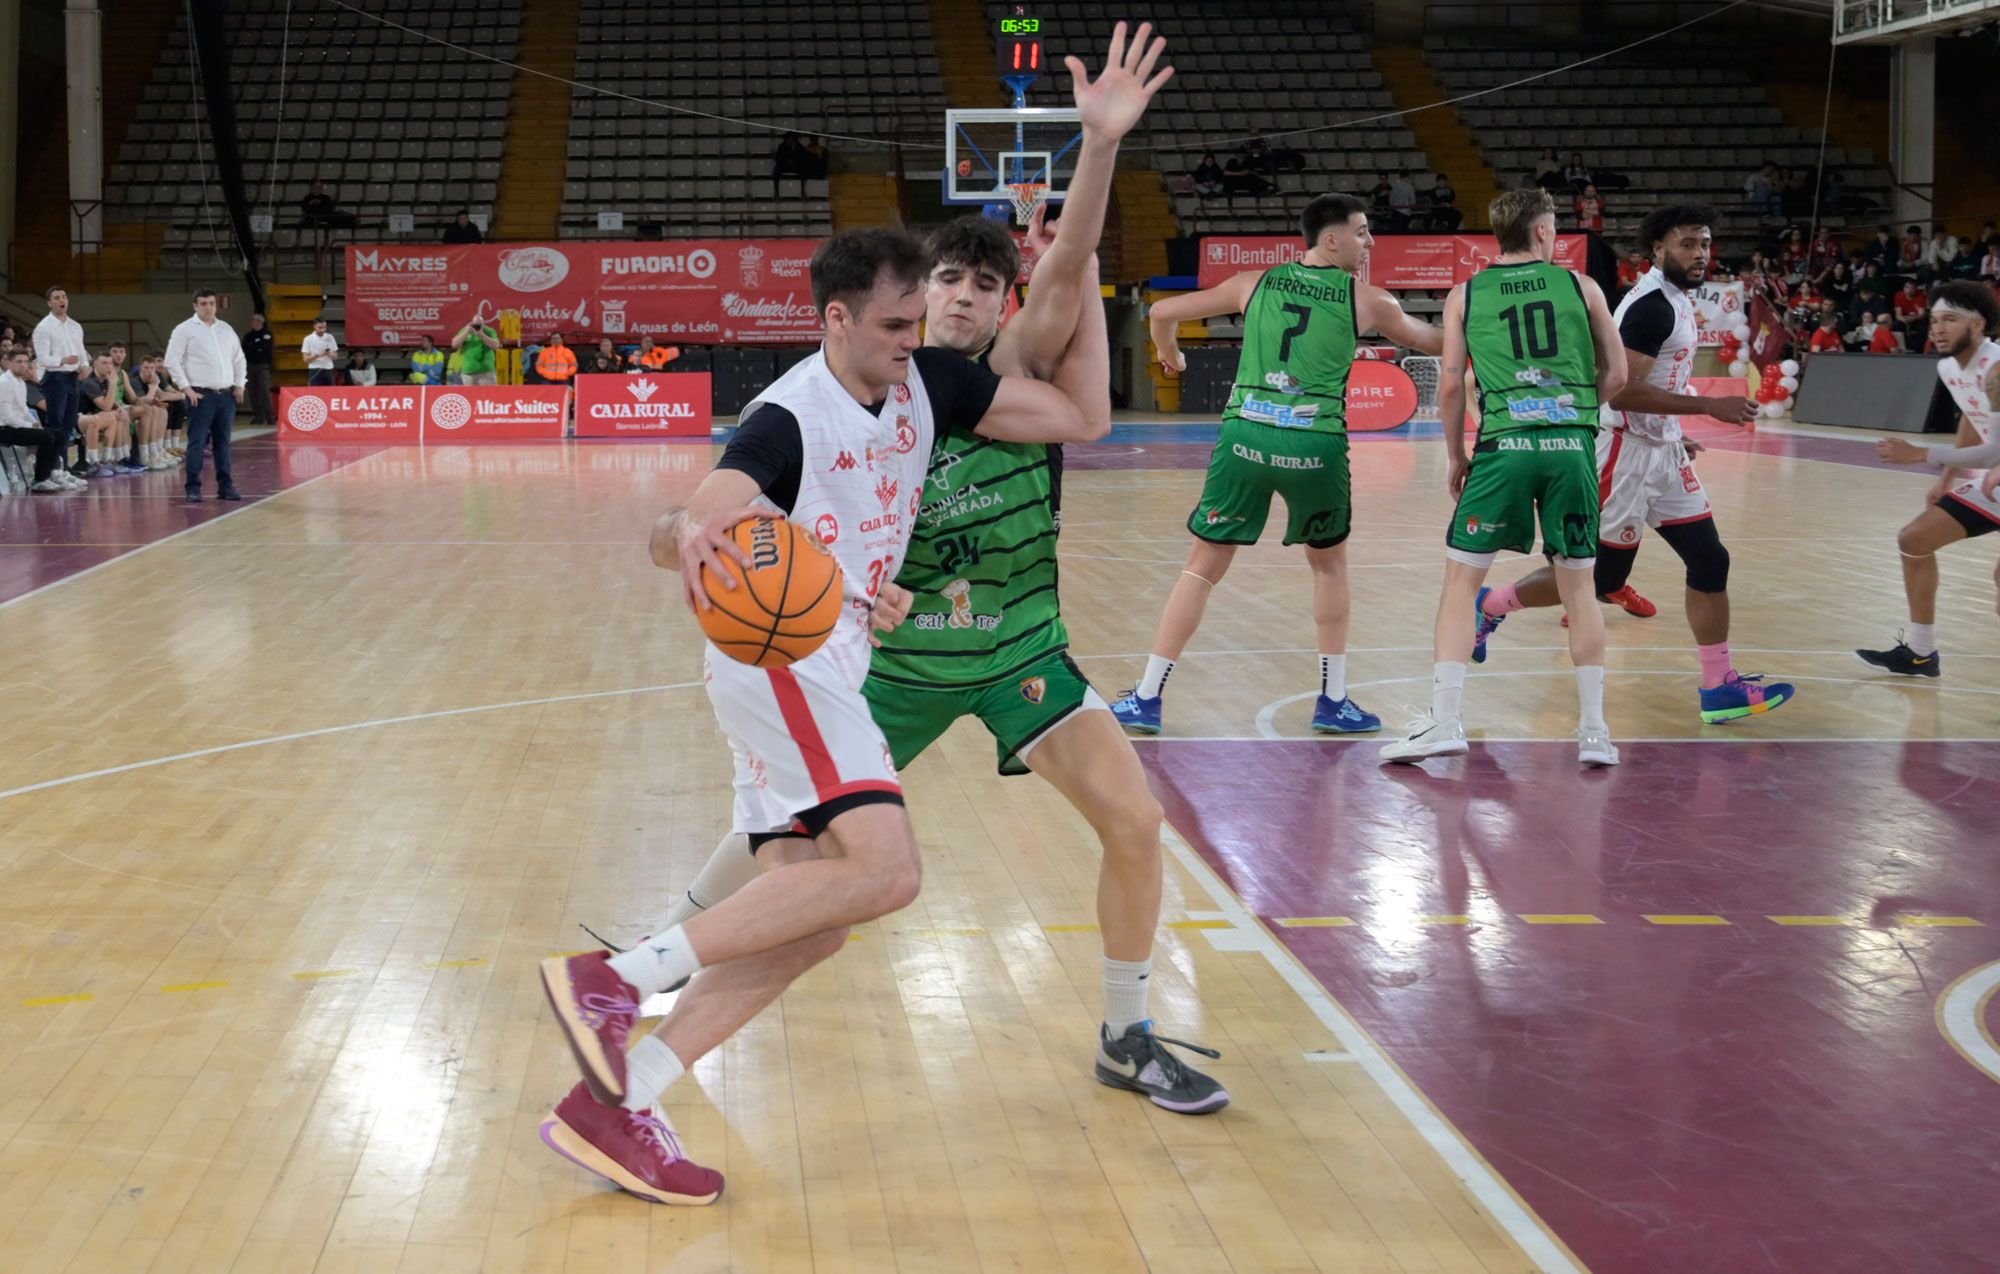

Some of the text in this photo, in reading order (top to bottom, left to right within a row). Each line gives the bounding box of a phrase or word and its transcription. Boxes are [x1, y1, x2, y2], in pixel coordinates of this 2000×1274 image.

[1001, 19, 1039, 32] 06:53
[1013, 42, 1039, 69] 11
[356, 250, 448, 272] MAYRES
[771, 258, 813, 267] universi
[1231, 243, 1305, 264] DentalCla
[1264, 276, 1347, 303] HIERREZUELO
[1500, 277, 1546, 296] MERLO
[378, 308, 439, 320] BECA CABLES
[631, 321, 719, 335] Aguas de León
[1279, 303, 1312, 363] 7
[1498, 300, 1558, 360] 10
[1351, 386, 1394, 398] PIRE
[331, 397, 414, 410] EL ALTAR
[473, 399, 559, 415] Altar Suites
[590, 403, 695, 418] CAJA RURAL
[1498, 437, 1583, 451] CAJA RURAL
[1232, 443, 1324, 469] CAJA RURAL
[928, 491, 1004, 527] FERRADA
[935, 533, 980, 576] 24
[915, 612, 945, 630] cat
[977, 609, 1003, 631] re
